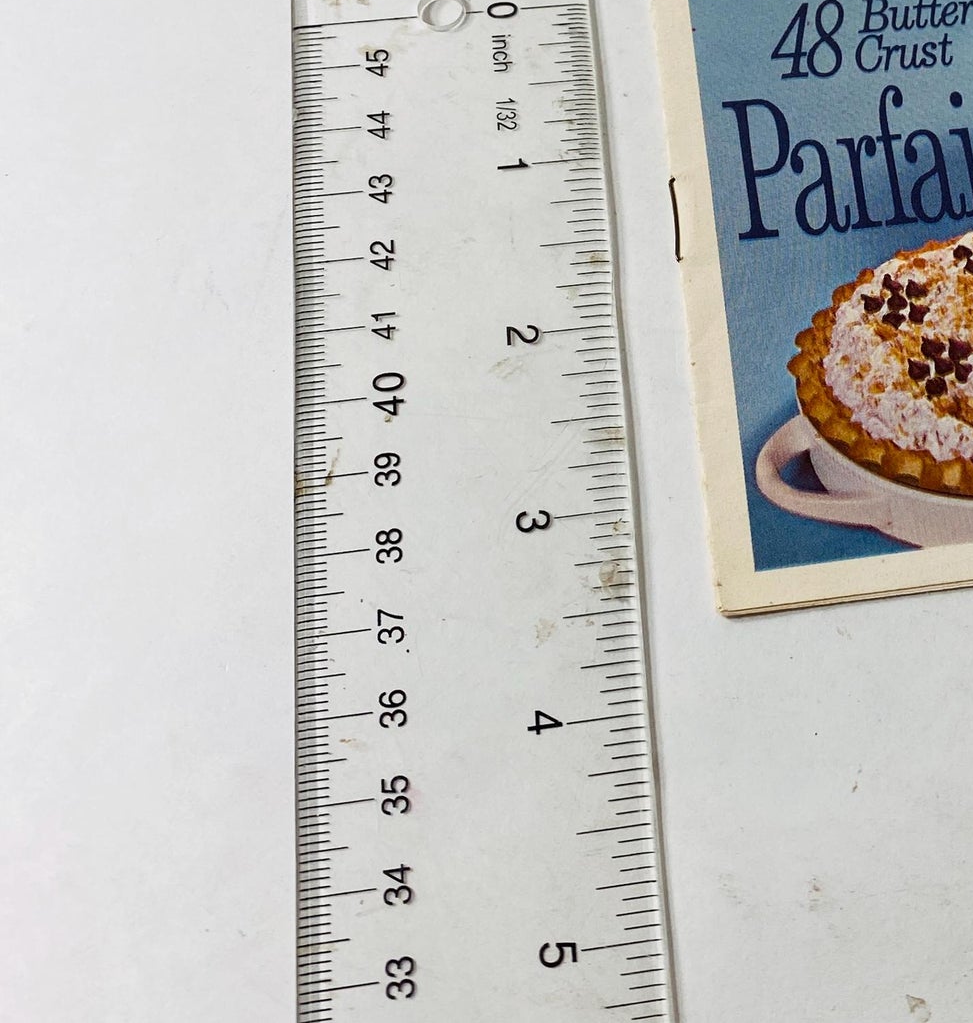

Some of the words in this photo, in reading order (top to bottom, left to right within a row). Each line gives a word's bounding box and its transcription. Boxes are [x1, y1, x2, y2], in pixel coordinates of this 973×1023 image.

[486, 2, 518, 19] 0
[365, 49, 390, 77] 45
[491, 34, 513, 73] inch
[855, 34, 953, 72] Crust
[367, 110, 391, 139] 44
[495, 96, 518, 131] 1/32
[497, 158, 529, 170] 1
[368, 173, 393, 203] 43
[370, 239, 395, 270] 42
[371, 311, 396, 339] 41
[506, 324, 539, 346] 2
[373, 372, 405, 415] 40
[374, 452, 401, 487] 39
[516, 510, 550, 533] 3
[376, 527, 403, 564] 38
[377, 609, 406, 644] 37
[379, 689, 407, 728] 36
[527, 710, 563, 735] 4
[382, 775, 410, 815] 35
[384, 864, 412, 905] 34
[539, 942, 578, 967] 5
[386, 956, 416, 999] 33
